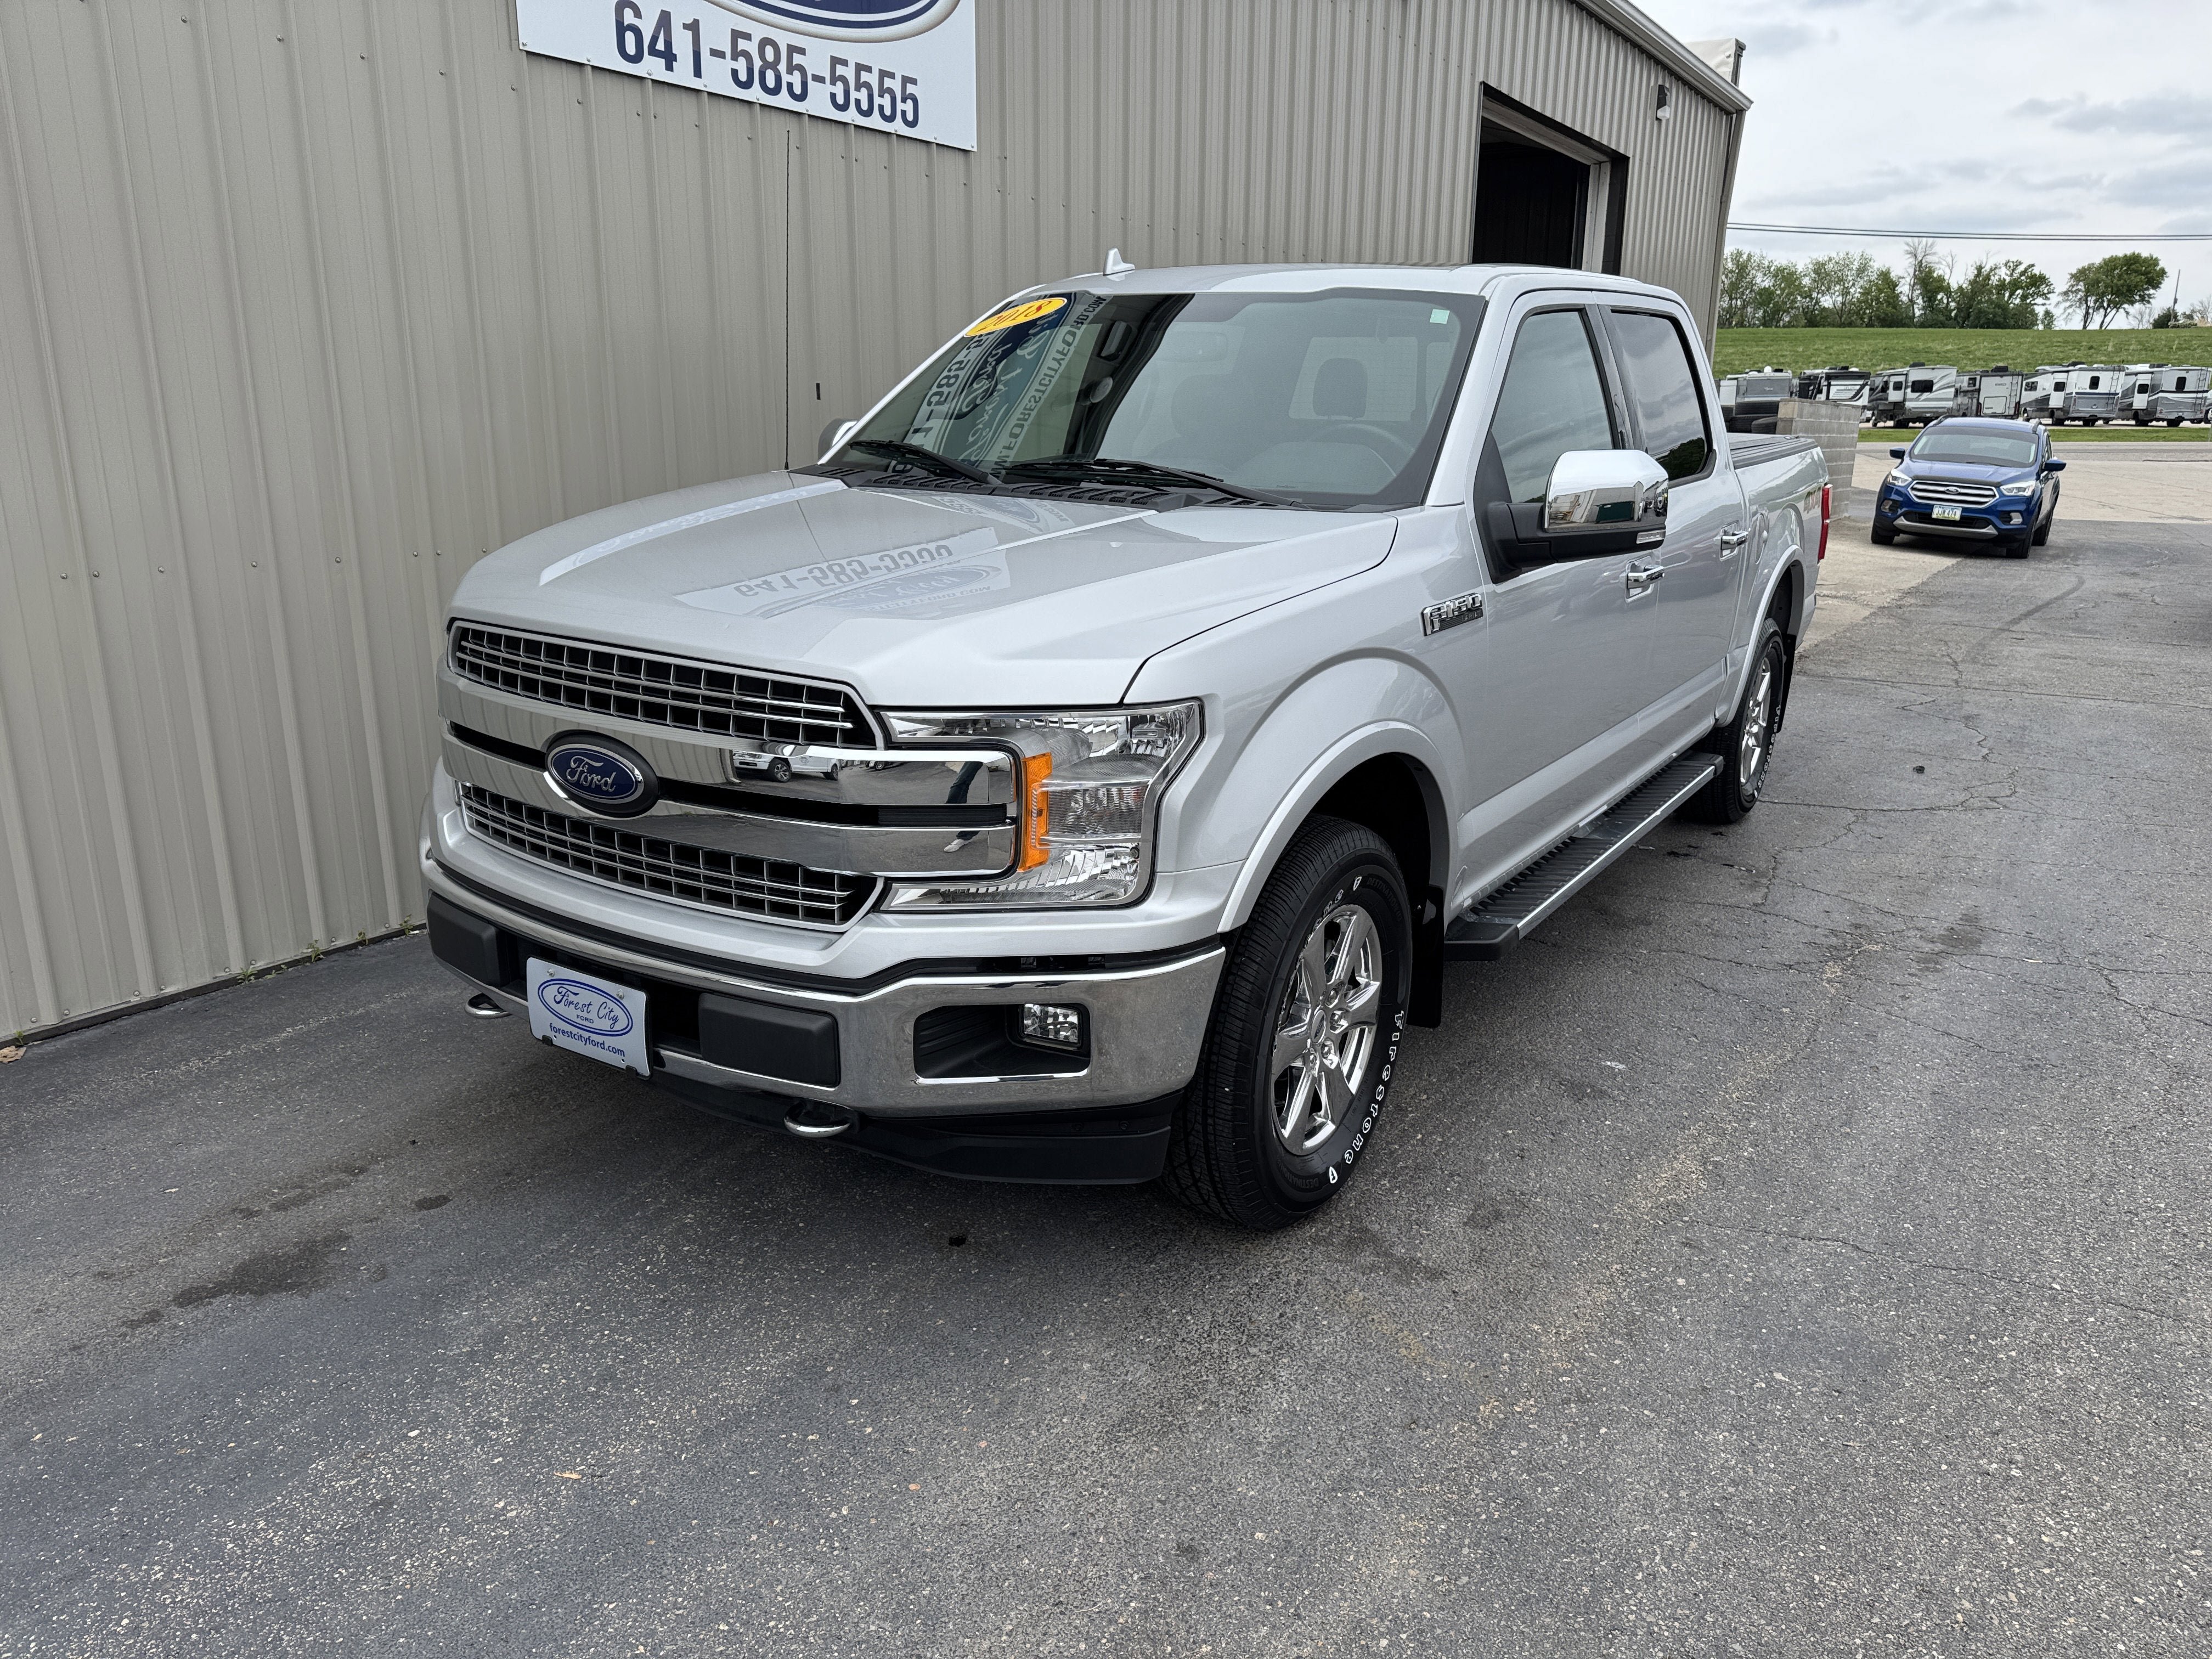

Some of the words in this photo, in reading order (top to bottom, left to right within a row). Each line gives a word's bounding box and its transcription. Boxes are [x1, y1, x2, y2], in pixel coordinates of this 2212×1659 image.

[614, 0, 919, 128] 641-585-5555
[975, 300, 1052, 333] 2018
[566, 755, 617, 793] Ford
[553, 985, 593, 1014] Forest
[596, 1001, 620, 1029] City
[576, 1014, 594, 1024] FORD
[549, 1023, 626, 1057] forestcityford.com
[1344, 1011, 1404, 1164] Firestone
